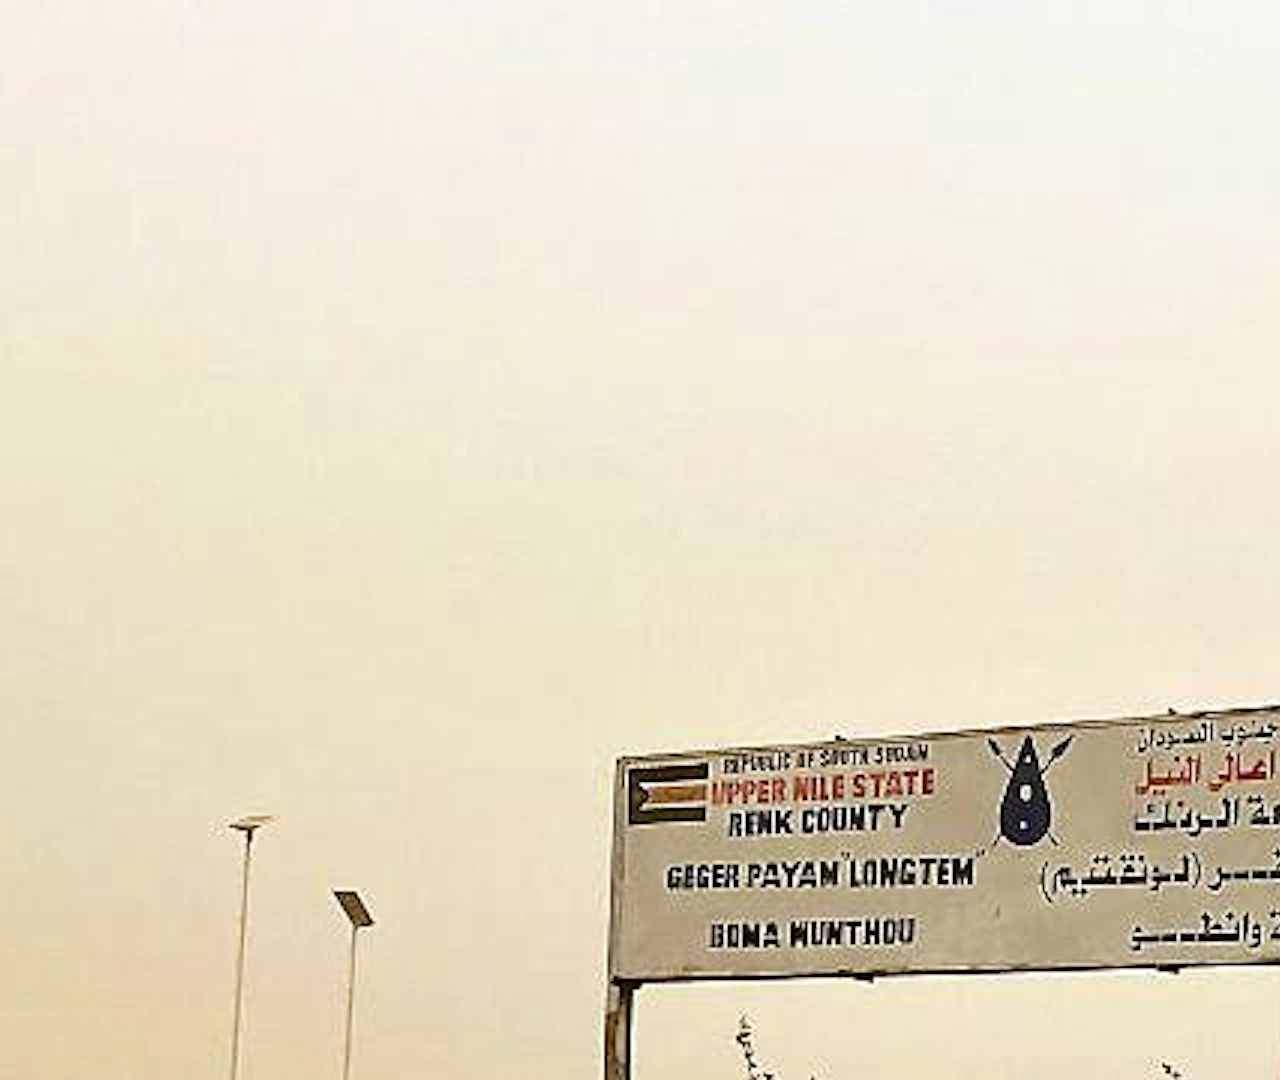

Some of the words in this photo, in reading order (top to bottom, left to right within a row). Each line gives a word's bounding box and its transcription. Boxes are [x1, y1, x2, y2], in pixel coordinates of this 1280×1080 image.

[1137, 721, 1215, 753] السودان
[1221, 719, 1280, 747] جنوب
[796, 751, 815, 769] OF
[1135, 753, 1203, 796] النيل
[711, 776, 787, 805] UPPER
[793, 774, 846, 802] NILE
[853, 768, 936, 799] STATE
[729, 808, 794, 838] RENK
[802, 804, 910, 835] COUNTY
[1134, 797, 1240, 837] الرنك
[666, 862, 740, 890] GEGER
[709, 921, 782, 949] BOMA
